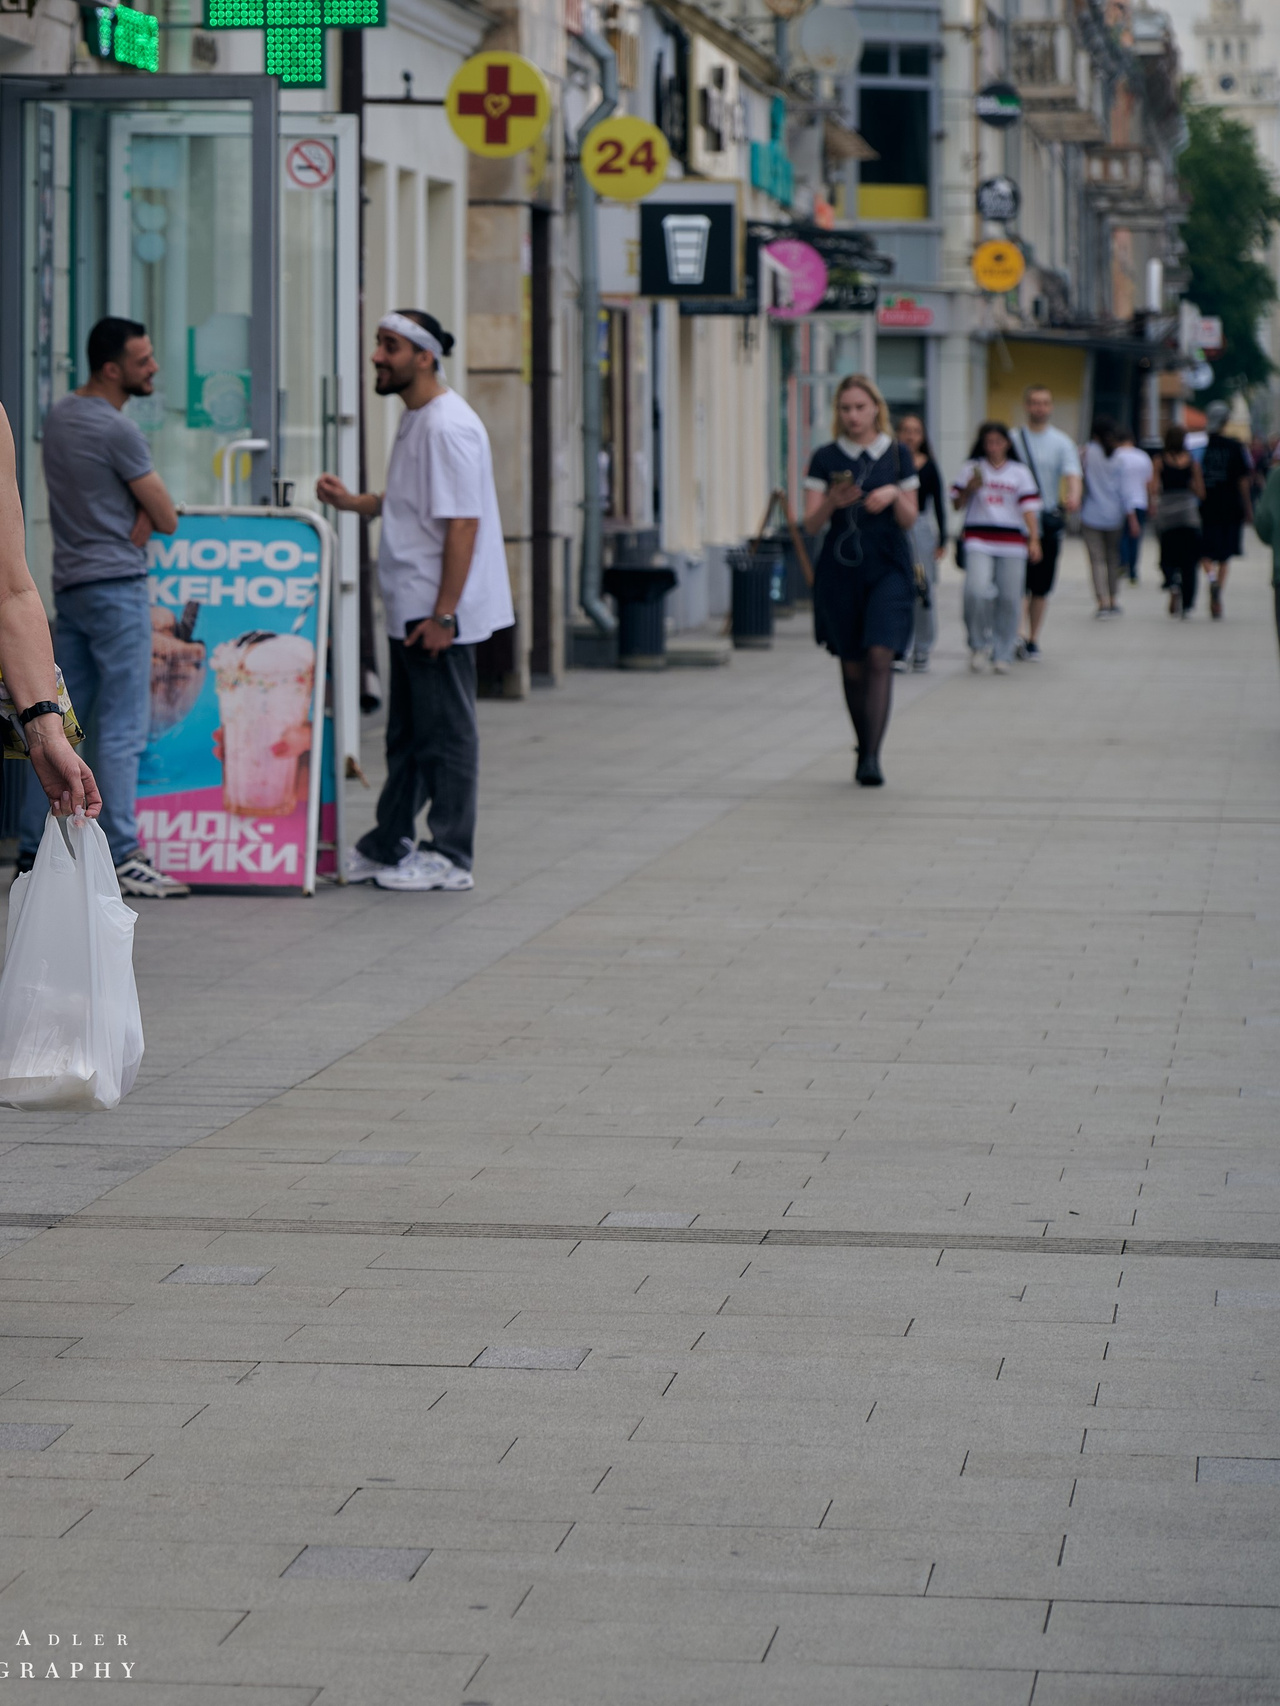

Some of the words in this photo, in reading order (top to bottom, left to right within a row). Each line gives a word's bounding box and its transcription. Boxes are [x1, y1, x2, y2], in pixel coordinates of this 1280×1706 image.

[596, 140, 658, 174] 24
[148, 539, 318, 571] МОРО-
[146, 839, 298, 874] ЕЙКИ
